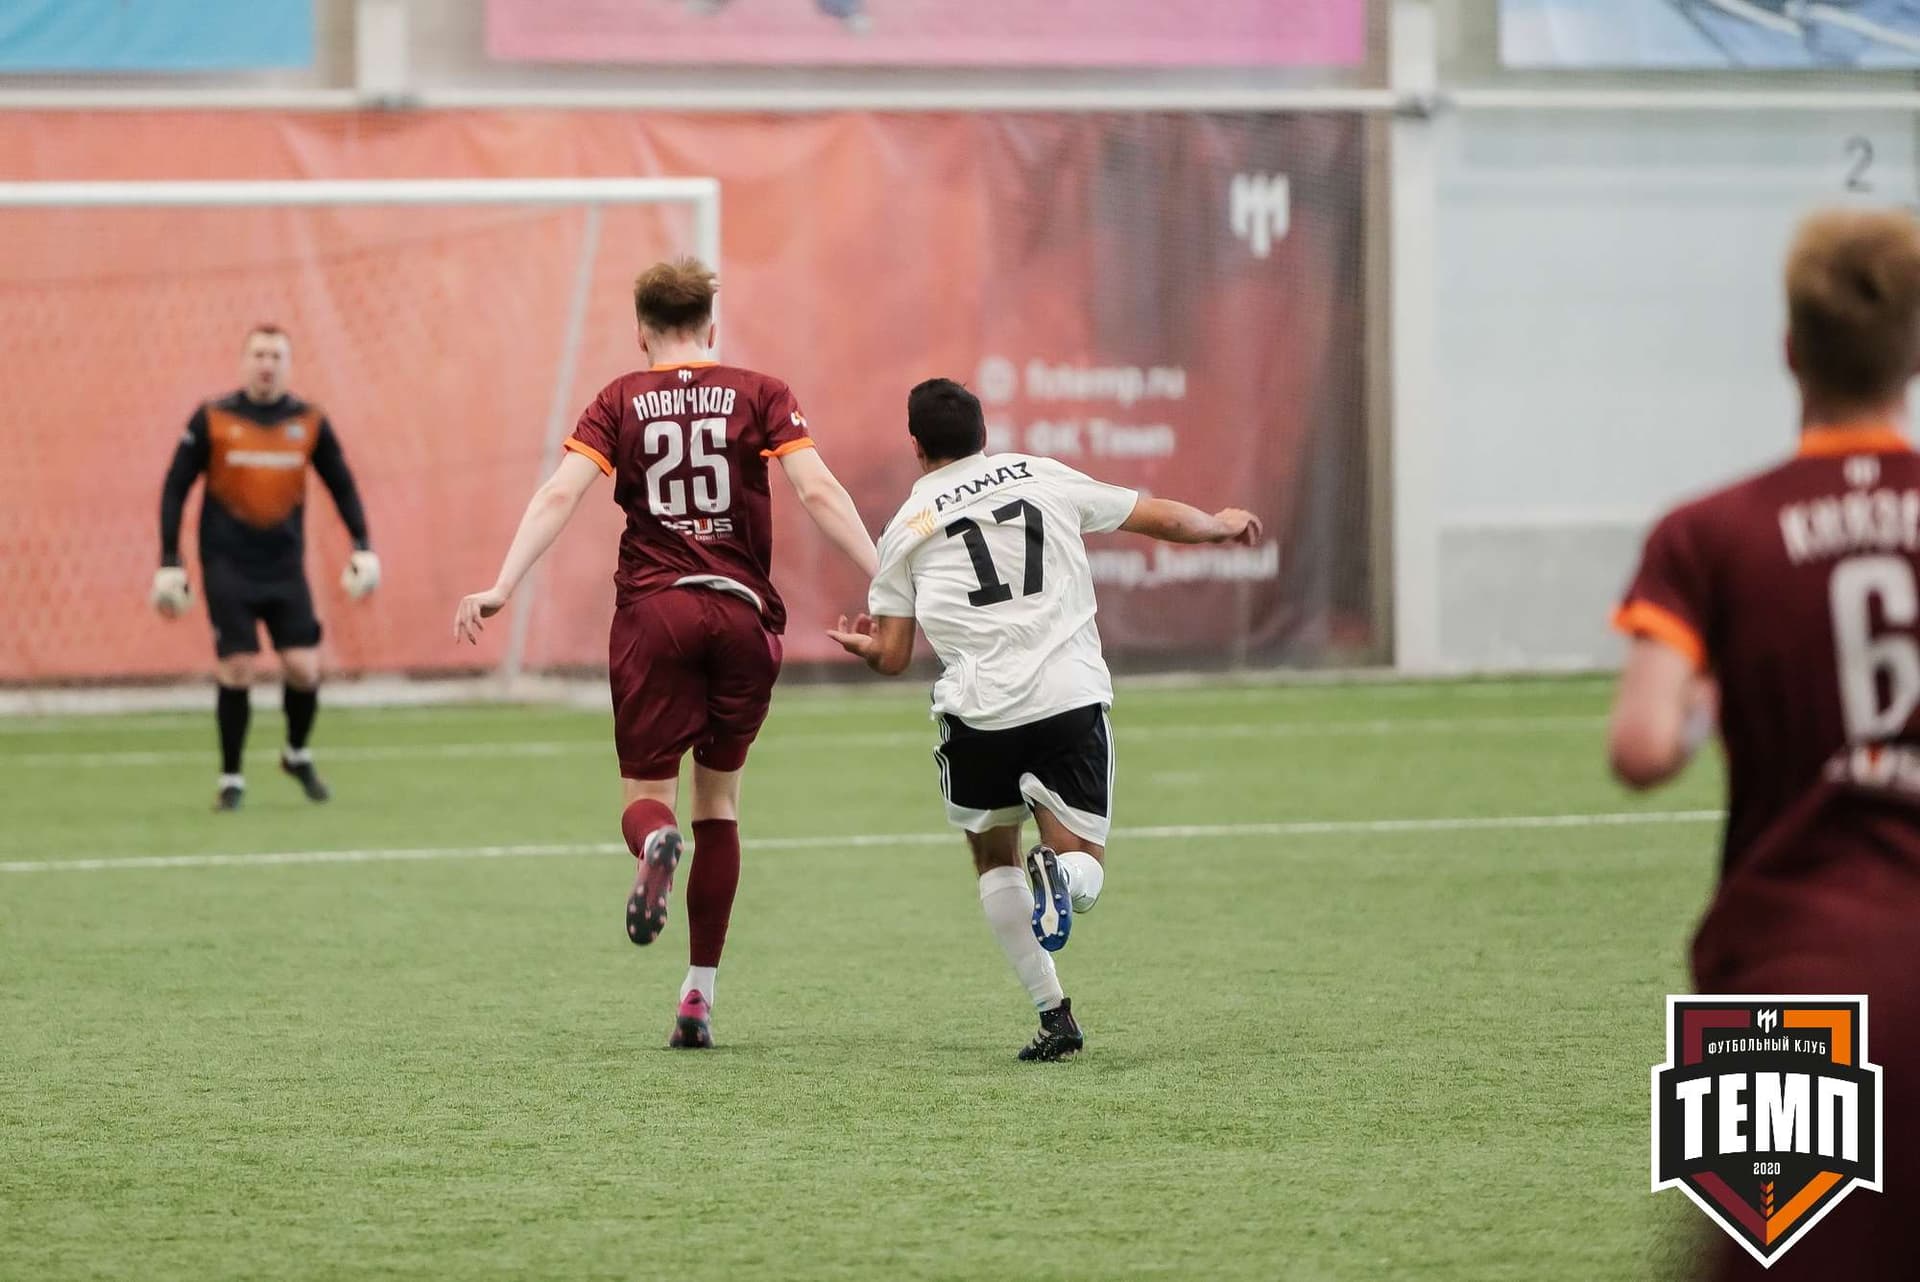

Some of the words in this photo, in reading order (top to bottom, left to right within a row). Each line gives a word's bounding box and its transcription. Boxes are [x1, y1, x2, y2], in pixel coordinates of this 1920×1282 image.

[1845, 136, 1874, 193] 2
[632, 386, 737, 421] НОВИЧКОВ
[644, 418, 731, 515] 25
[945, 498, 1044, 606] 17
[1829, 554, 1920, 744] 6
